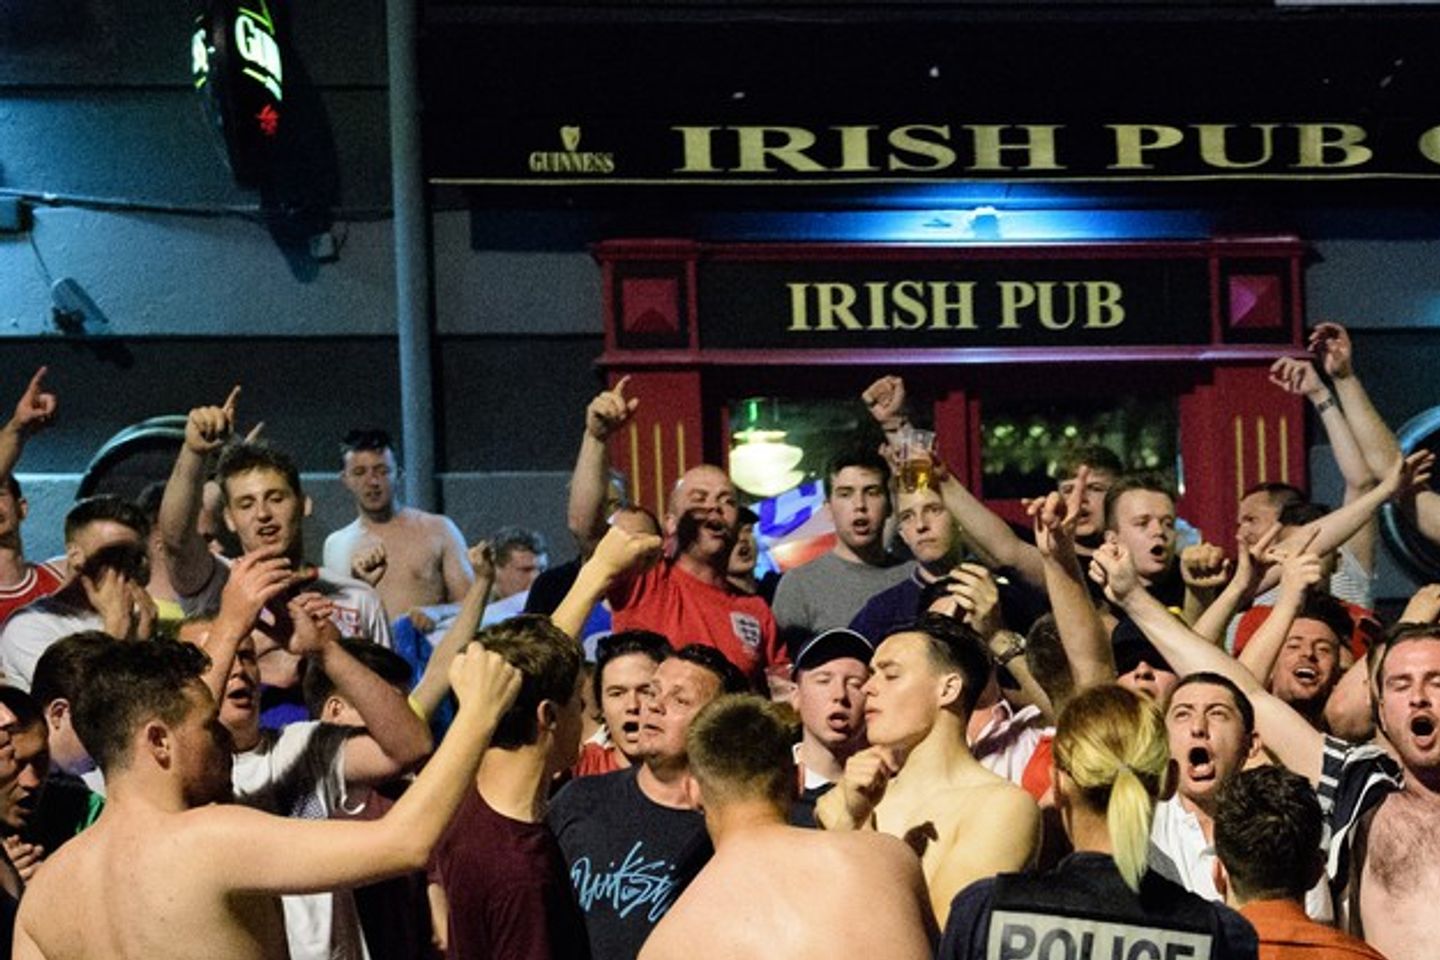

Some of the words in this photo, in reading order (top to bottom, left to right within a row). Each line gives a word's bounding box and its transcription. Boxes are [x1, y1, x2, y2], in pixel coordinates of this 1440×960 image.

[529, 151, 615, 173] GUINNESS
[671, 124, 1067, 172] IRISH
[1104, 123, 1373, 169] PUB
[786, 280, 978, 331] IRISH
[996, 280, 1126, 331] PUB
